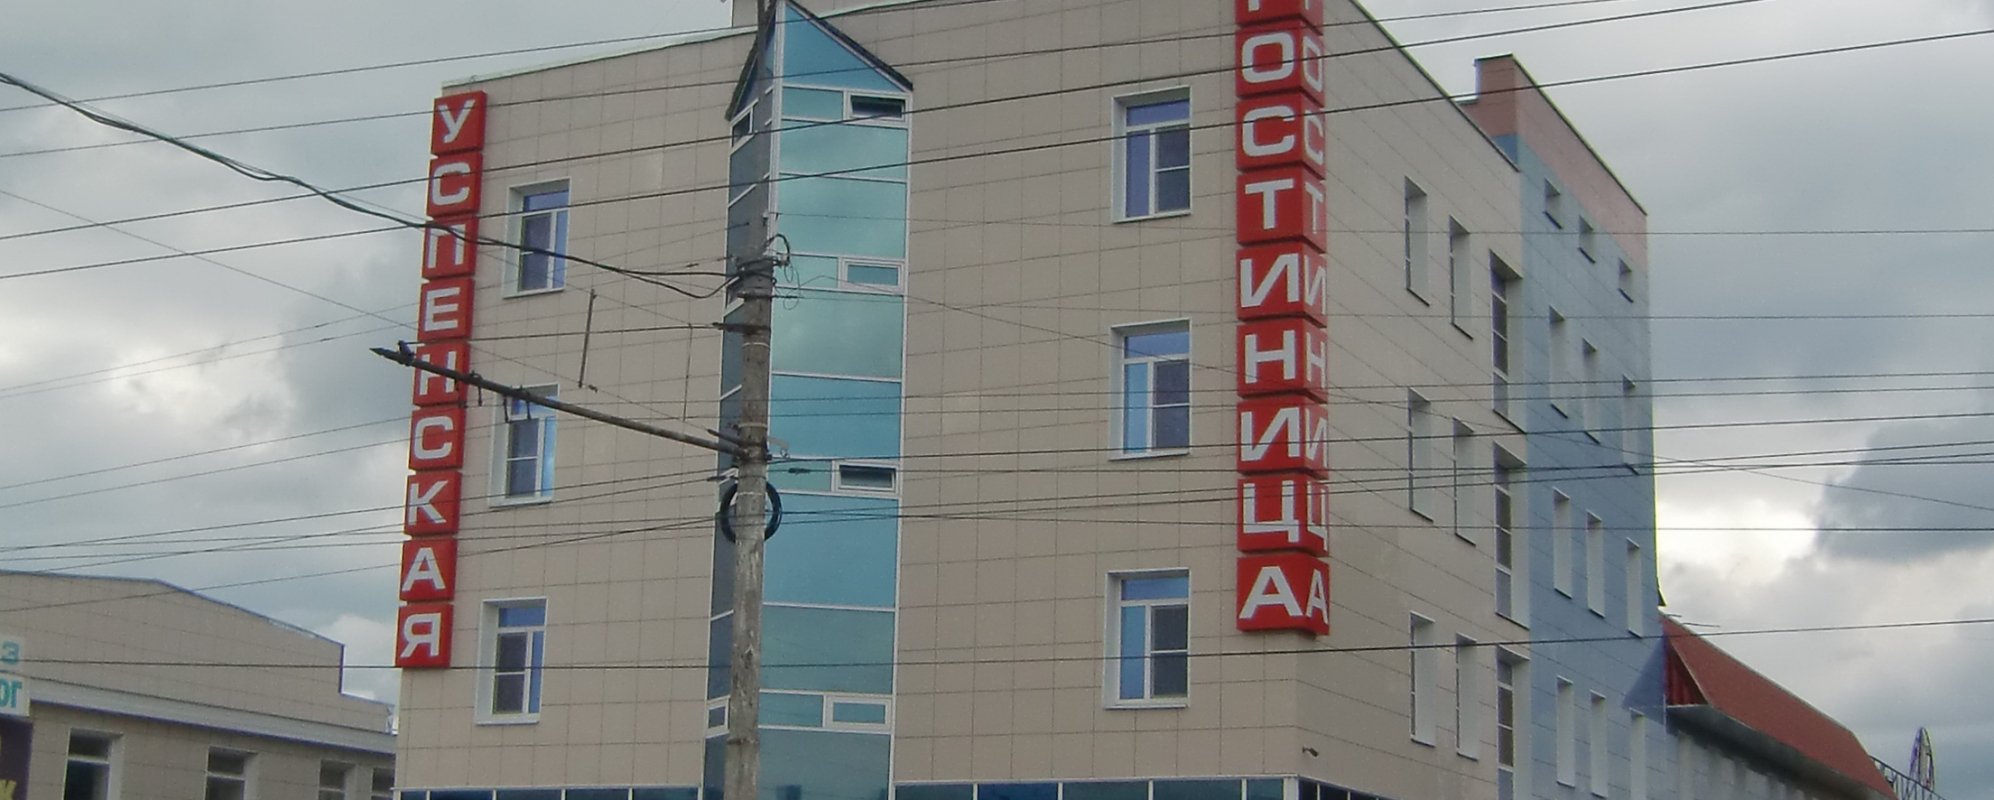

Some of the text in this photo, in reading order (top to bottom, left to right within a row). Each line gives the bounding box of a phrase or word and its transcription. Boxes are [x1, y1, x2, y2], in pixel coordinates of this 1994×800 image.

[400, 99, 476, 658] УСПЕНСКАЯ
[1239, 0, 1303, 619] ОСТИНИЦА
[1302, 0, 1328, 624] ОСТИНИЦА
